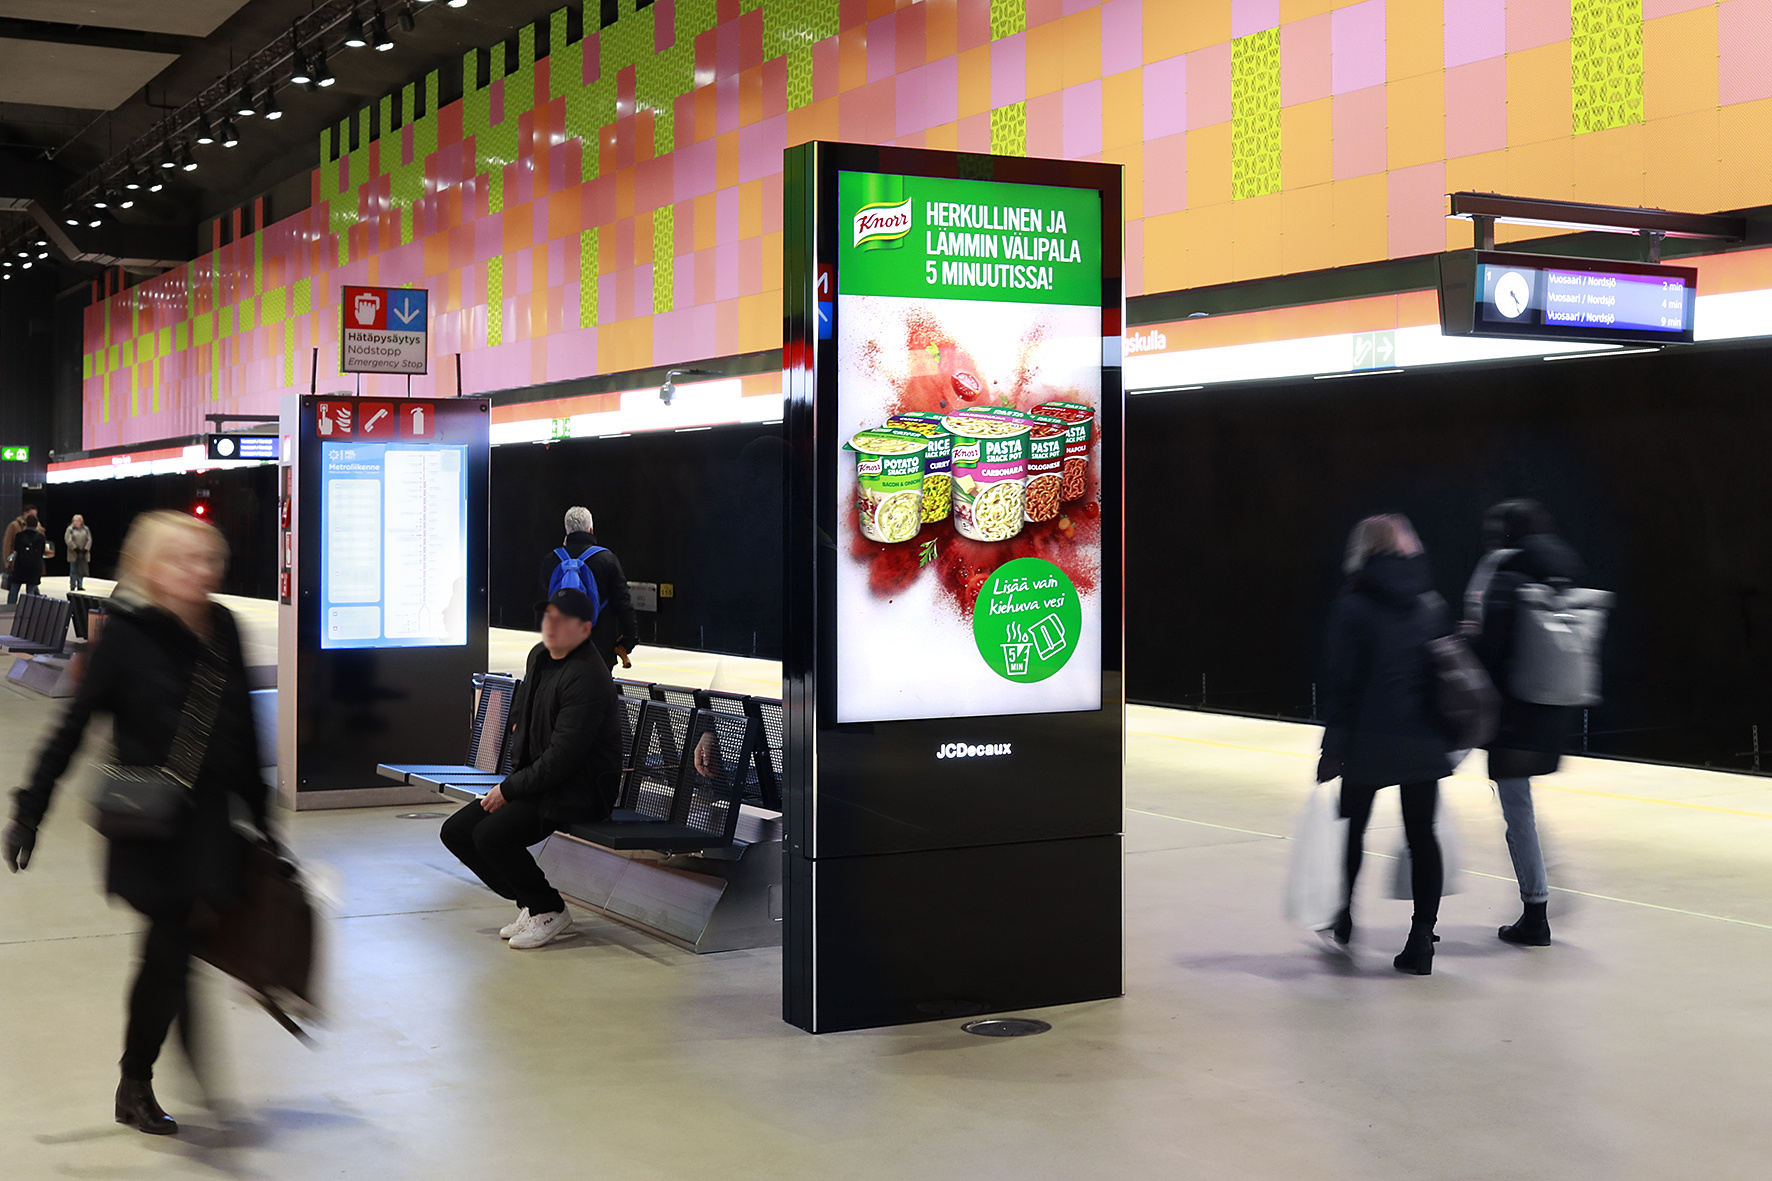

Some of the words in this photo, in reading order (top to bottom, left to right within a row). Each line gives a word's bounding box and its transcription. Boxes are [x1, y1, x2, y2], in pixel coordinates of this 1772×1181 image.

[856, 212, 909, 234] Knorr
[926, 201, 1042, 232] HERKULLINEN
[1046, 210, 1067, 234] JA
[926, 227, 998, 259] LÄMMIN
[1002, 232, 1081, 263] VÄLIPALA
[925, 260, 938, 284] 5
[941, 261, 1053, 290] MINUUTISSA!
[1549, 273, 1582, 285] Vuosaari
[1588, 278, 1617, 288] Nordsjö
[1662, 281, 1668, 291] 2
[1669, 282, 1684, 292] min
[1548, 291, 1581, 303] Vuosaari
[1587, 295, 1616, 306] Nordsjö
[1662, 299, 1668, 309] 4
[1669, 300, 1683, 310] min
[1547, 310, 1581, 322] Vuosaari
[1586, 312, 1615, 324] Nordsjö
[1661, 316, 1667, 326] 9
[1668, 318, 1682, 328] min
[348, 332, 421, 346] Hätäpysäytys
[348, 344, 402, 357] Nödstopp
[348, 357, 399, 369] Emergency
[402, 360, 423, 369] Stop
[1066, 426, 1086, 438] ASTA
[928, 439, 951, 451] RICE
[986, 439, 1022, 455] PASTA
[1032, 440, 1060, 453] PASTA
[1066, 445, 1087, 453] NAPOLI
[953, 448, 979, 459] Knorr
[987, 454, 1008, 462] SNACK
[1009, 452, 1022, 460] POT
[328, 463, 381, 471] Metroliikenne
[859, 463, 881, 472] Knorr
[884, 457, 919, 469] POTATO
[1027, 461, 1060, 470] BOLOGNESE
[907, 466, 919, 474] POT
[981, 465, 1023, 476] CARBONARA
[993, 578, 1029, 595] Lisää
[1032, 575, 1058, 589] vain
[989, 594, 1040, 615] kiehuva
[1043, 593, 1066, 608] vesi
[1008, 648, 1016, 663] 5
[1010, 663, 1024, 671] MIN
[936, 742, 1012, 760] JCDecaux
